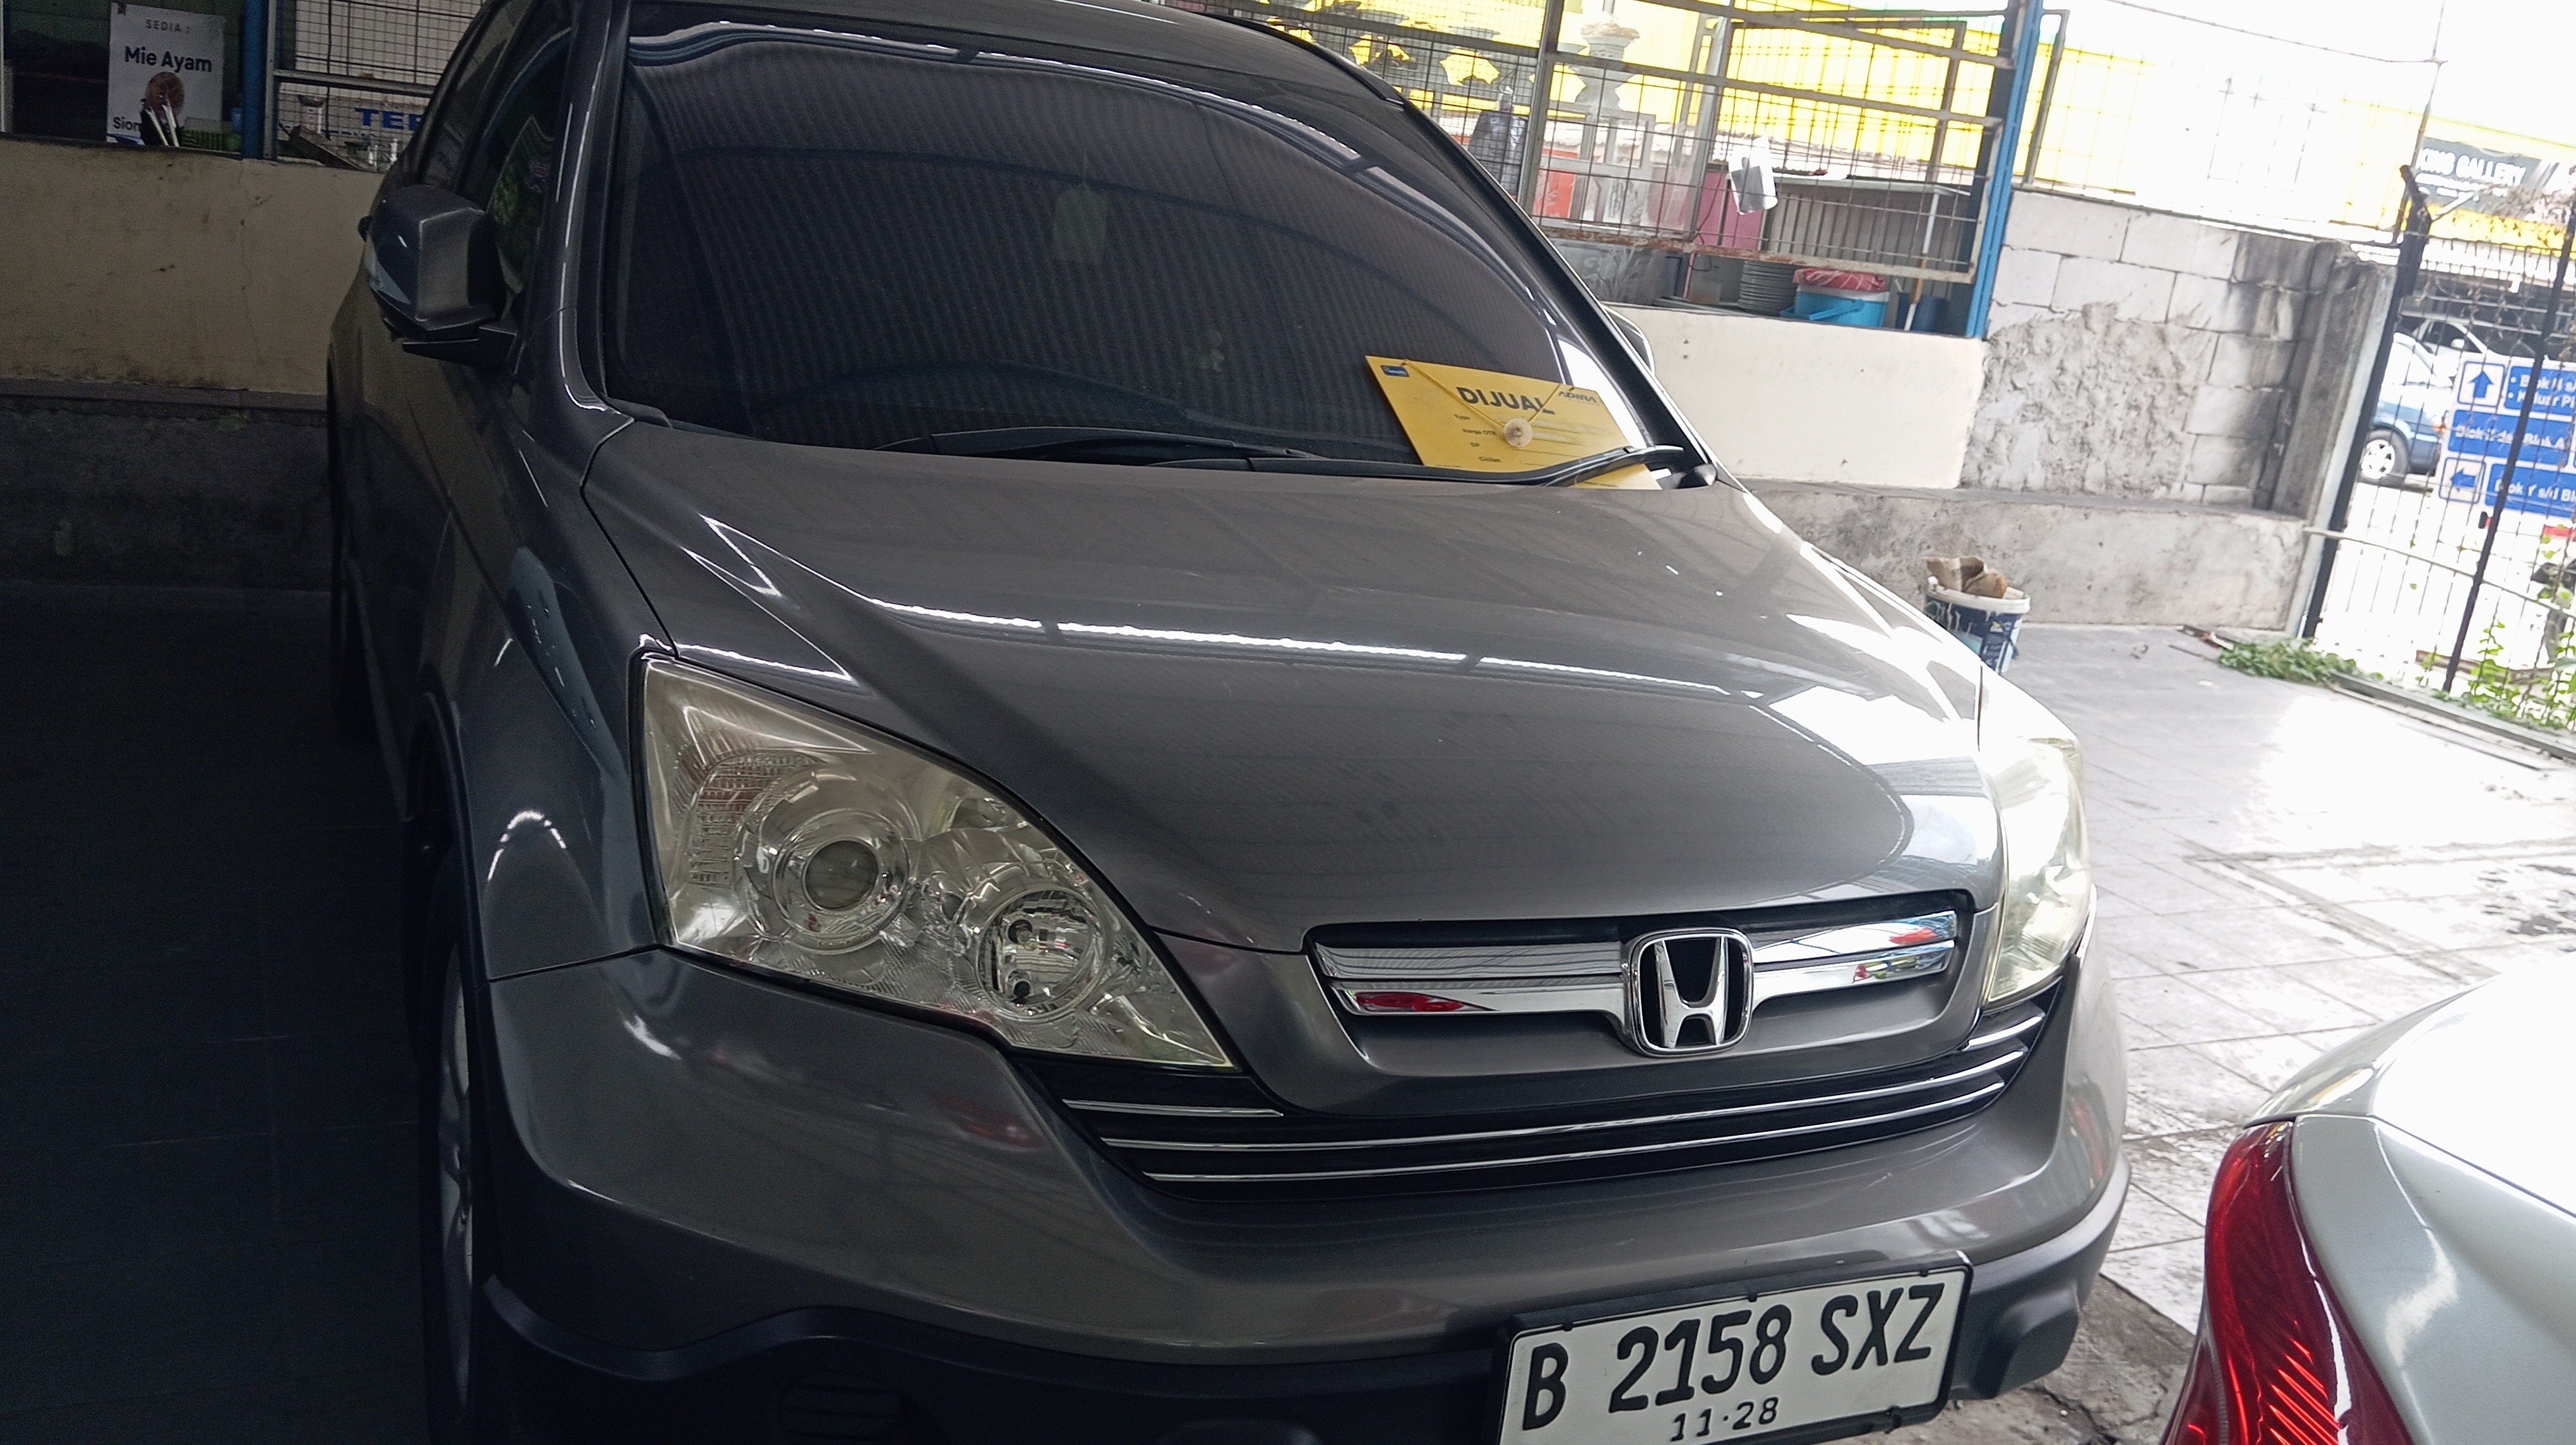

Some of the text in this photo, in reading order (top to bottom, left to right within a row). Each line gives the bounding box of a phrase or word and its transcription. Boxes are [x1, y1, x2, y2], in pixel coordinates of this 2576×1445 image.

[145, 19, 181, 32] SEDIA
[125, 45, 213, 73] Mie Ayam
[2455, 155, 2526, 188] GALLERY
[1455, 386, 1556, 415] DIJUAL
[1522, 1283, 1945, 1430] B 2158 SXZ
